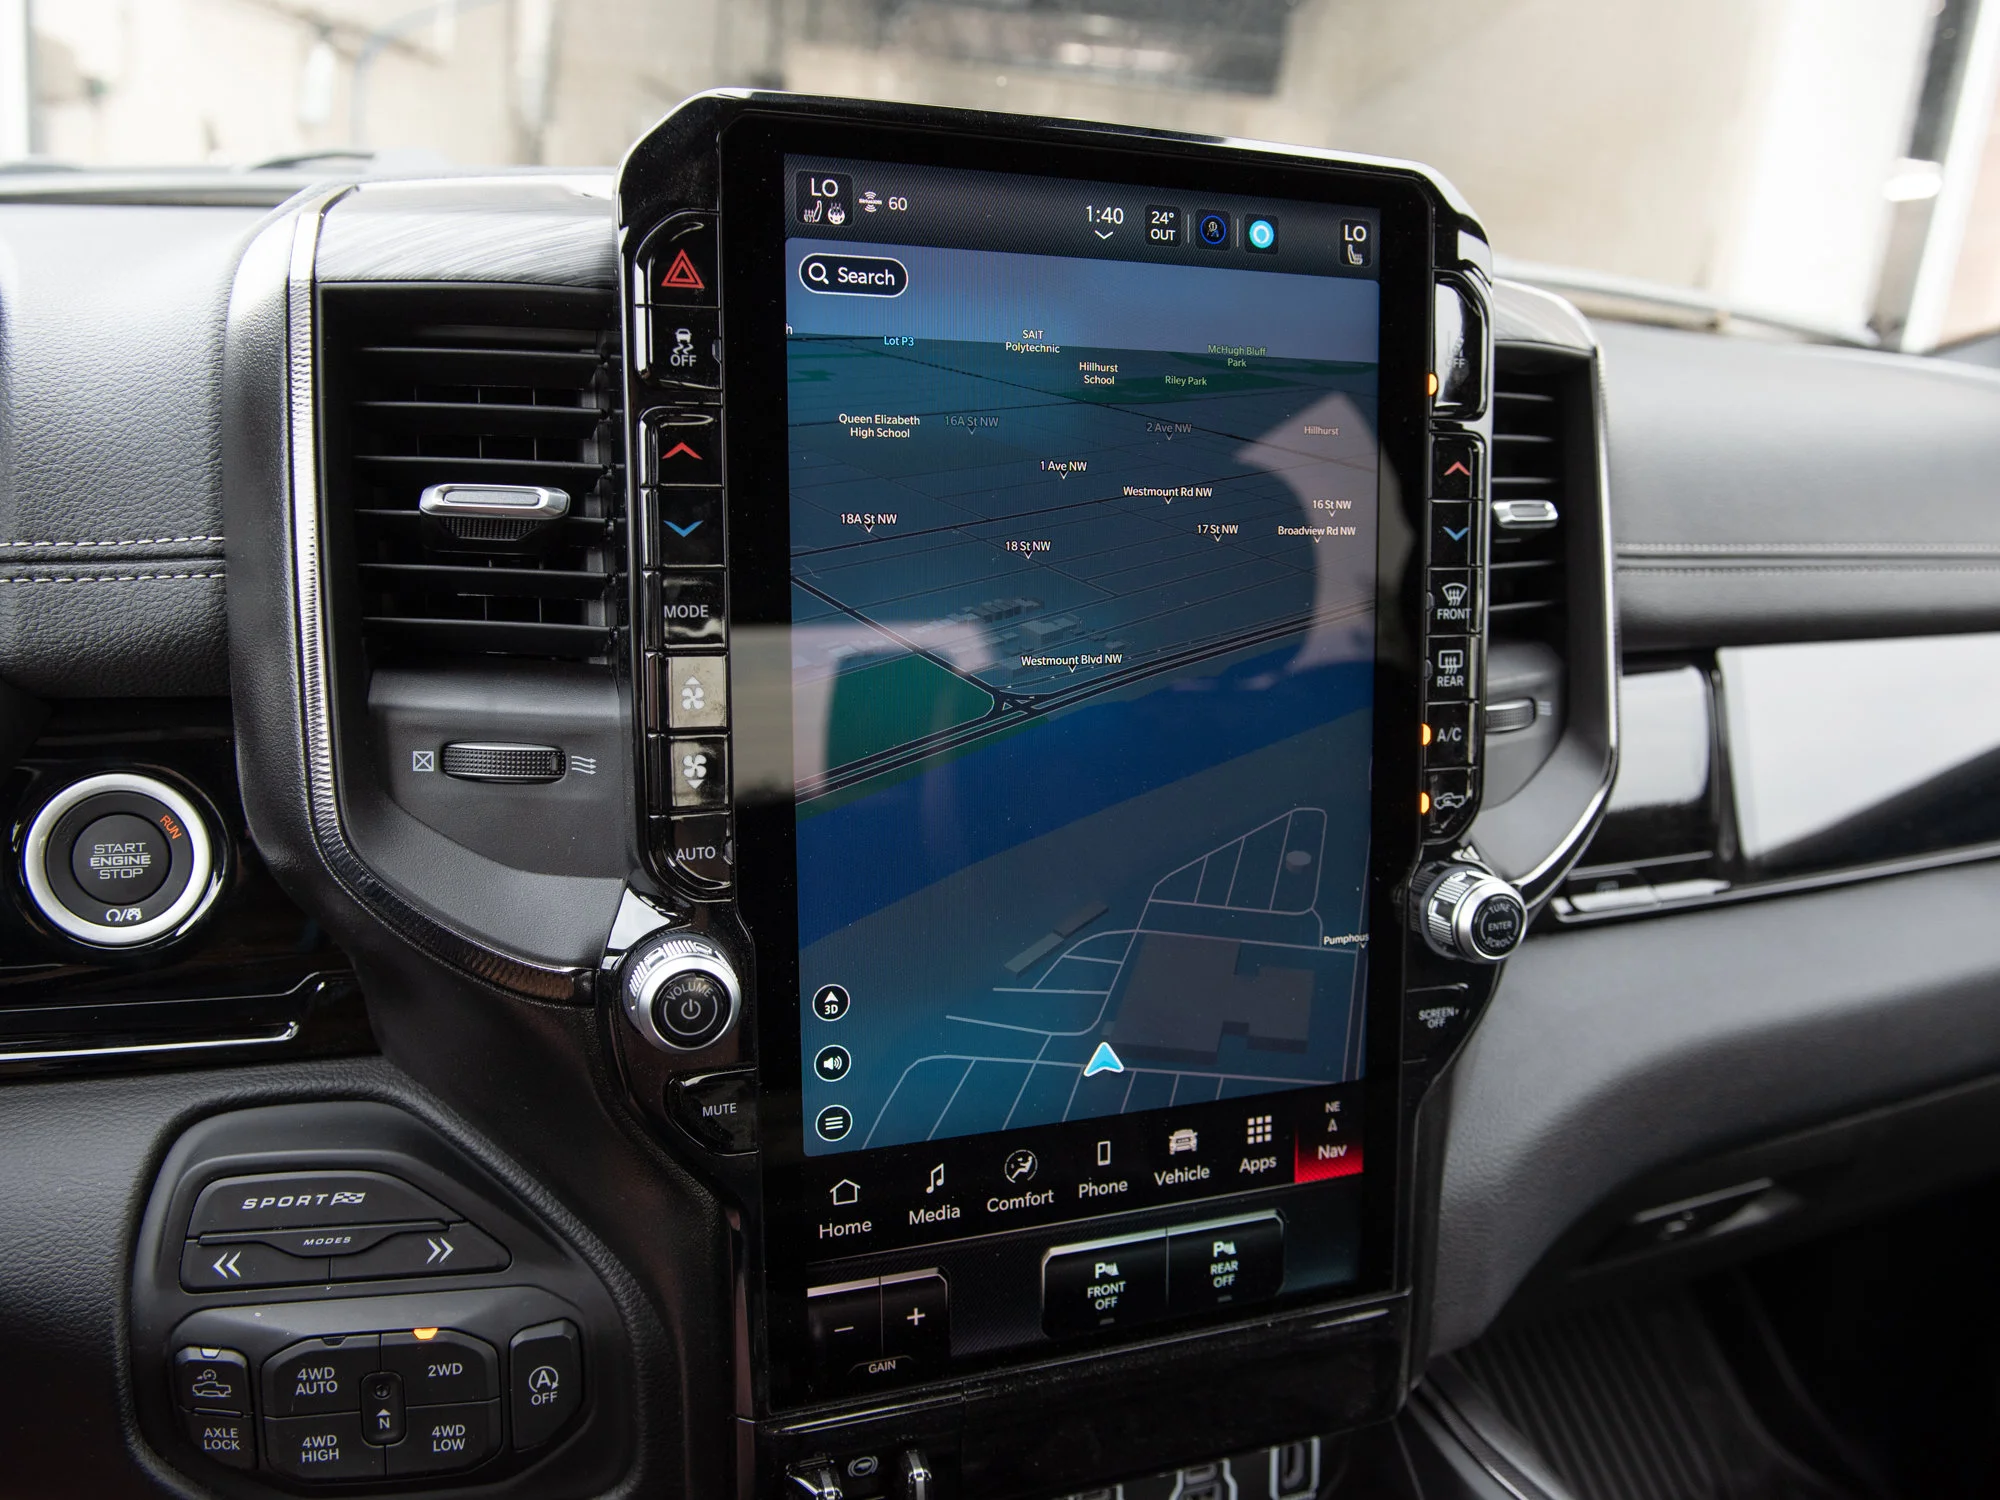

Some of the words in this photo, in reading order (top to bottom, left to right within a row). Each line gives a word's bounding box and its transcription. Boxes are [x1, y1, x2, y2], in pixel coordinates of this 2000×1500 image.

[810, 178, 838, 197] LO
[888, 197, 907, 211] 60
[1085, 205, 1124, 225] 1:40
[1151, 211, 1175, 225] 24°
[1150, 228, 1176, 241] OUT
[1344, 224, 1367, 242] LO
[837, 267, 895, 286] Search
[1022, 329, 1043, 340] SAIT
[884, 336, 899, 346] Lot
[902, 336, 914, 347] P3
[1005, 341, 1060, 354] Polytechnic
[1207, 344, 1244, 356] McHugh
[1246, 345, 1267, 356] Bluff
[670, 354, 697, 367] OFF
[1079, 361, 1119, 373] Hillhurst
[1227, 358, 1247, 368] Park
[1084, 374, 1115, 385] School
[1165, 375, 1186, 387] Riley
[1187, 376, 1207, 386] Park
[838, 413, 873, 425] Queen
[875, 414, 920, 426] Elizabeth
[944, 416, 965, 427] 16A
[967, 416, 979, 427] St
[980, 416, 999, 427] NW
[850, 427, 874, 440] High
[876, 427, 910, 438] School
[1146, 422, 1153, 432] 2
[1154, 423, 1173, 433] Ave
[1174, 424, 1192, 433] NW
[1304, 425, 1340, 436] Hillhurst
[1040, 461, 1046, 471] 1
[1047, 461, 1067, 471] Ave
[1069, 461, 1087, 472] NW
[1123, 486, 1179, 497] Westmount
[1180, 487, 1194, 497] Rd
[1195, 487, 1213, 498] NW
[1312, 500, 1324, 510] 16
[1325, 500, 1335, 510] St
[1335, 501, 1352, 510] NW
[840, 513, 862, 524] 18A
[863, 513, 876, 524] St
[877, 513, 897, 524] NW
[1197, 524, 1208, 534] 17
[1210, 524, 1220, 534] St
[1221, 525, 1239, 535] NW
[1278, 526, 1325, 536] Broadview
[1326, 526, 1339, 536] Rd
[1340, 526, 1356, 536] NW
[1005, 541, 1018, 551] 18
[1019, 541, 1031, 551] St
[1032, 541, 1051, 551] NW
[664, 605, 709, 619] MODE
[1437, 608, 1472, 620] FRONT
[1021, 655, 1079, 666] Westmount
[1081, 654, 1103, 665] Blvd
[1104, 654, 1123, 665] NW
[1436, 676, 1464, 687] REAR
[1437, 728, 1462, 742] A/C
[160, 814, 182, 840] RUN
[94, 842, 146, 854] START
[675, 846, 717, 861] AUTO
[90, 855, 151, 867] ENGINE
[99, 868, 143, 879] STOP
[1489, 903, 1512, 914] TUNE
[1488, 921, 1513, 931] ENTER
[1485, 935, 1514, 948] SCROLL
[666, 981, 714, 1001] VOLUME
[824, 1004, 838, 1015] 3D
[1418, 1006, 1455, 1021] SCREEN
[1427, 1018, 1446, 1029] OFF
[702, 1103, 737, 1117] MUTE
[1325, 1101, 1341, 1113] NE
[1318, 1144, 1347, 1161] Nav
[1239, 1155, 1277, 1175] Apps
[1154, 1165, 1210, 1187] Vehicle
[1079, 1178, 1128, 1199] Phone
[241, 1193, 328, 1210] SPORT
[987, 1189, 1054, 1213] Comfort
[909, 1205, 961, 1225] Media
[819, 1219, 872, 1239] Home
[303, 1236, 351, 1246] MODES
[1210, 1261, 1239, 1275] REAR
[1213, 1274, 1235, 1288] OFF
[1087, 1282, 1125, 1299] FRONT
[1095, 1296, 1117, 1310] OFF
[297, 1367, 335, 1380] 4WD
[428, 1363, 463, 1377] 2WD
[868, 1360, 896, 1374] GAIN
[295, 1381, 338, 1396] AUTO
[531, 1392, 558, 1406] OFF
[379, 1418, 391, 1429] N
[204, 1427, 239, 1439] AXLE
[431, 1424, 466, 1438] 4WD
[204, 1439, 240, 1451] LOCK
[302, 1435, 337, 1448] 4WD
[432, 1438, 466, 1452] LOW
[301, 1448, 340, 1464] HIGH
